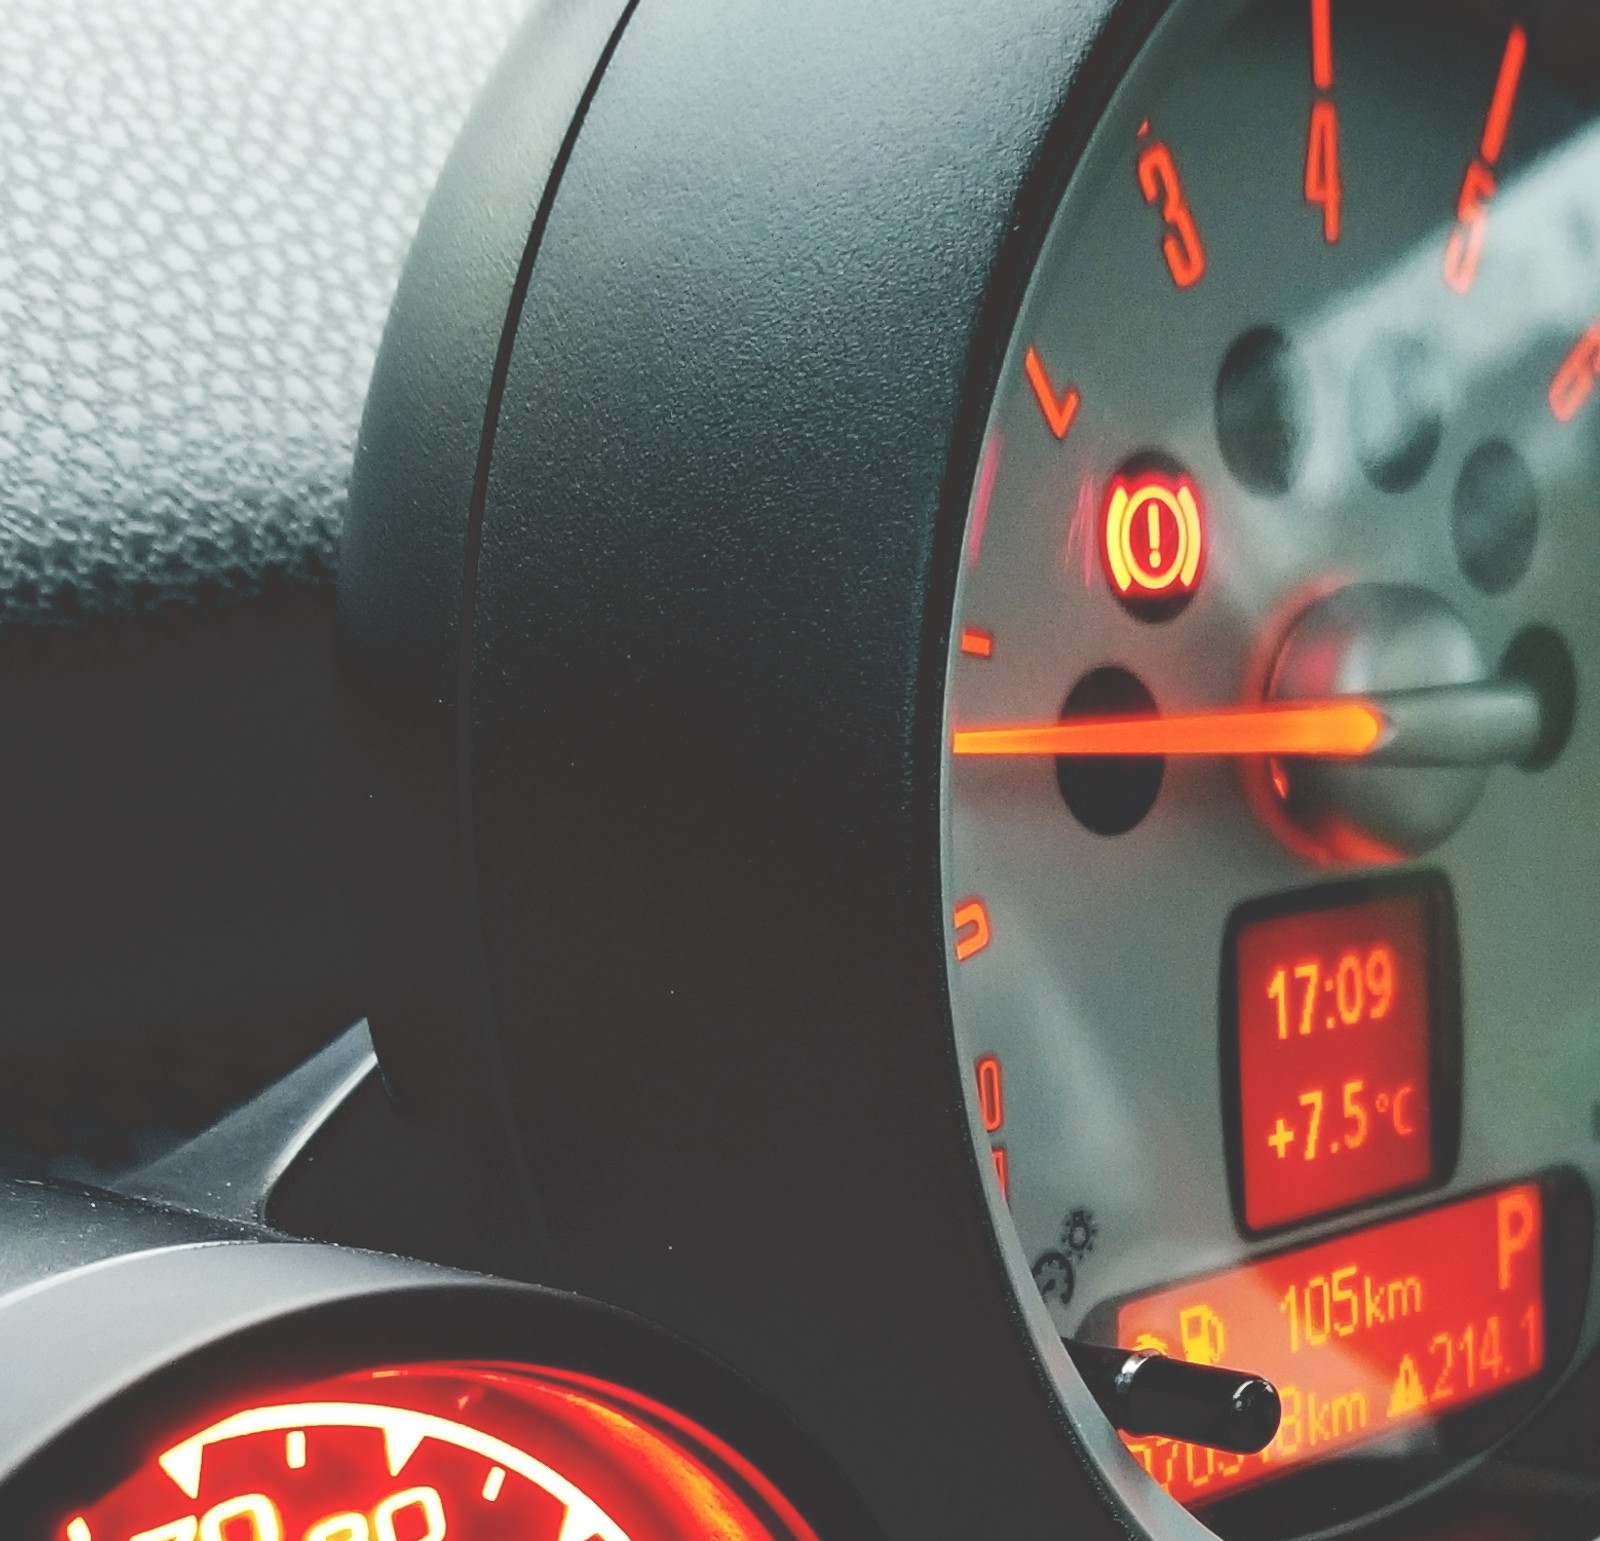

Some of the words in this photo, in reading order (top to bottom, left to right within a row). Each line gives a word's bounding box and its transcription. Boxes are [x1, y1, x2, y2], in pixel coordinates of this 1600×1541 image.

[1138, 143, 1205, 288] 3
[1304, 101, 1340, 244] 4
[1443, 161, 1496, 295] 5
[1267, 949, 1393, 1040] 17:09
[1498, 1194, 1533, 1290] P
